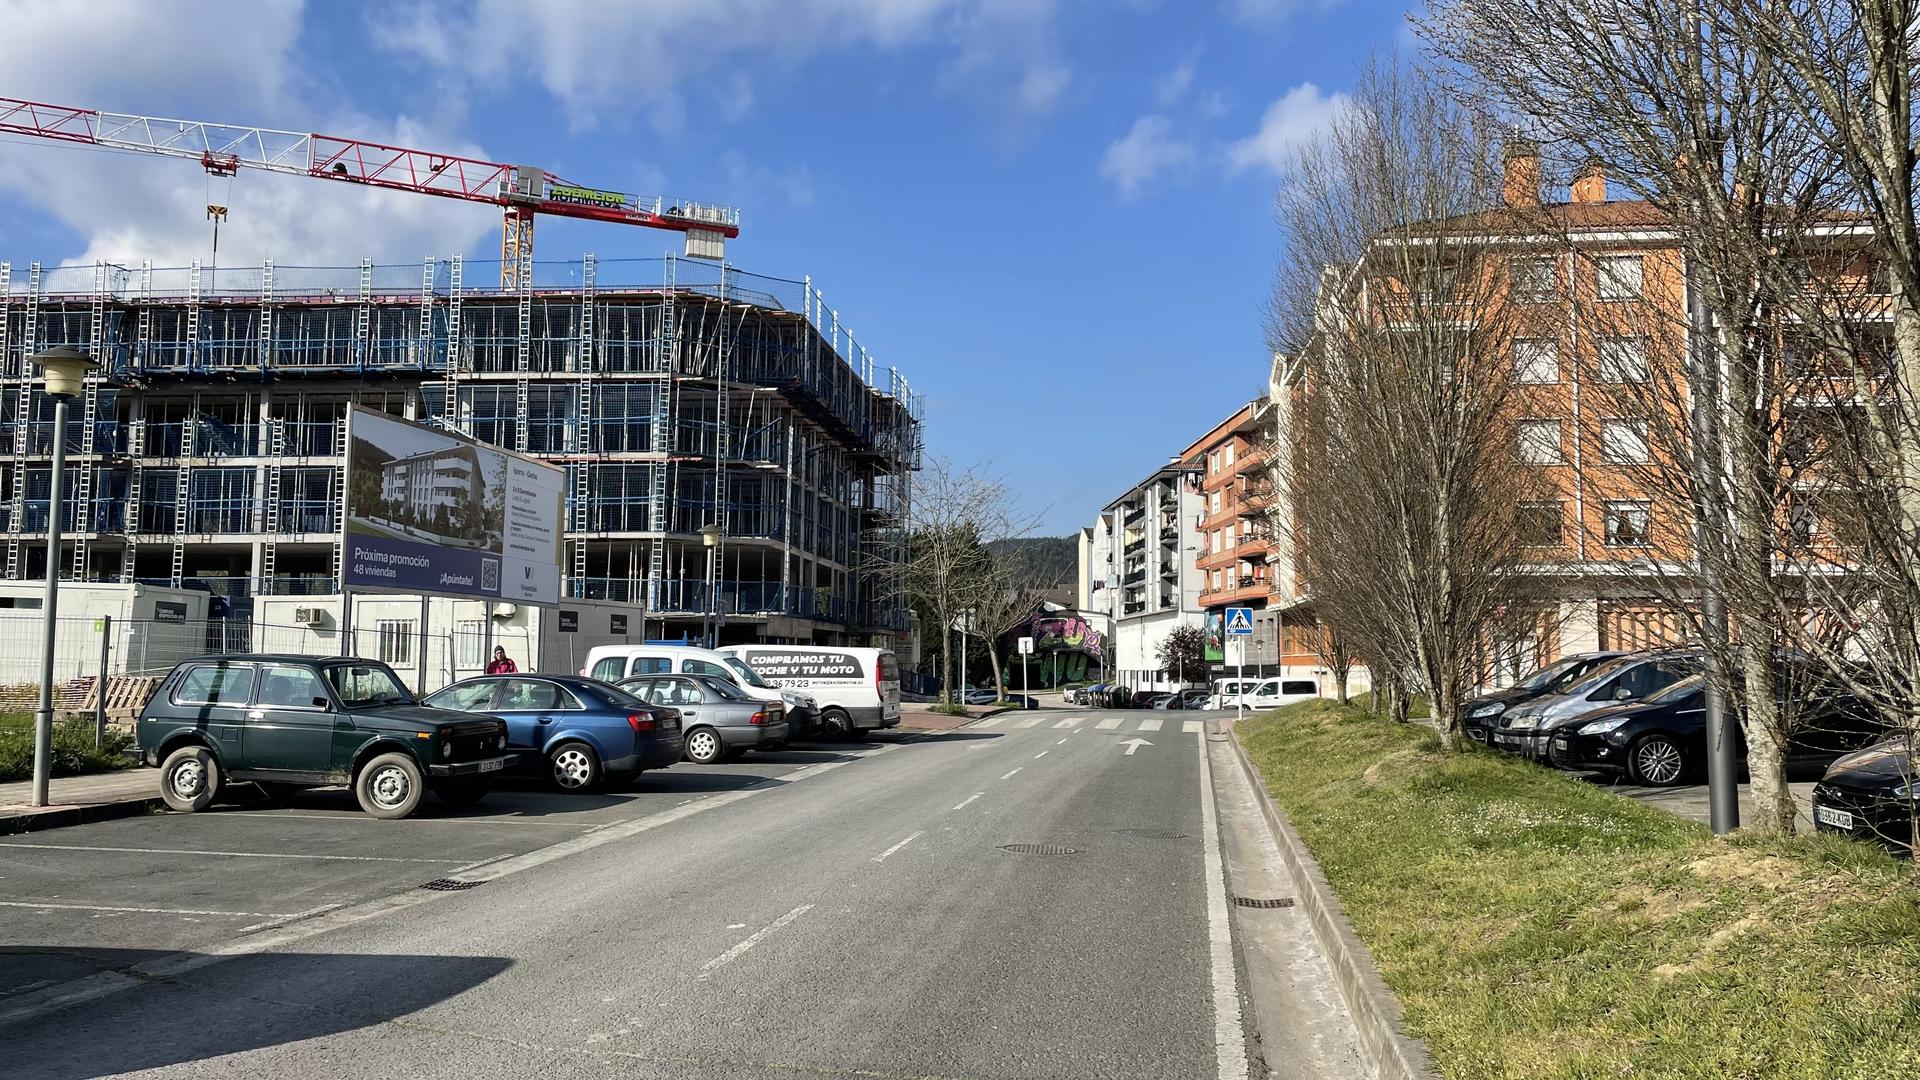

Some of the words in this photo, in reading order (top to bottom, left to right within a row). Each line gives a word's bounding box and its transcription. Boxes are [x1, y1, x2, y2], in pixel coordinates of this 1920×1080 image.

[354, 547, 389, 563] Próxima
[389, 555, 430, 568] promoción
[354, 564, 364, 574] 48
[365, 565, 397, 577] viviendas
[440, 572, 474, 586] ¡Apúntate!
[750, 655, 826, 665] COMPRAMOS
[829, 655, 845, 663] TU
[790, 666, 800, 675] Y
[802, 666, 820, 674] TU
[820, 665, 855, 674] MOTO
